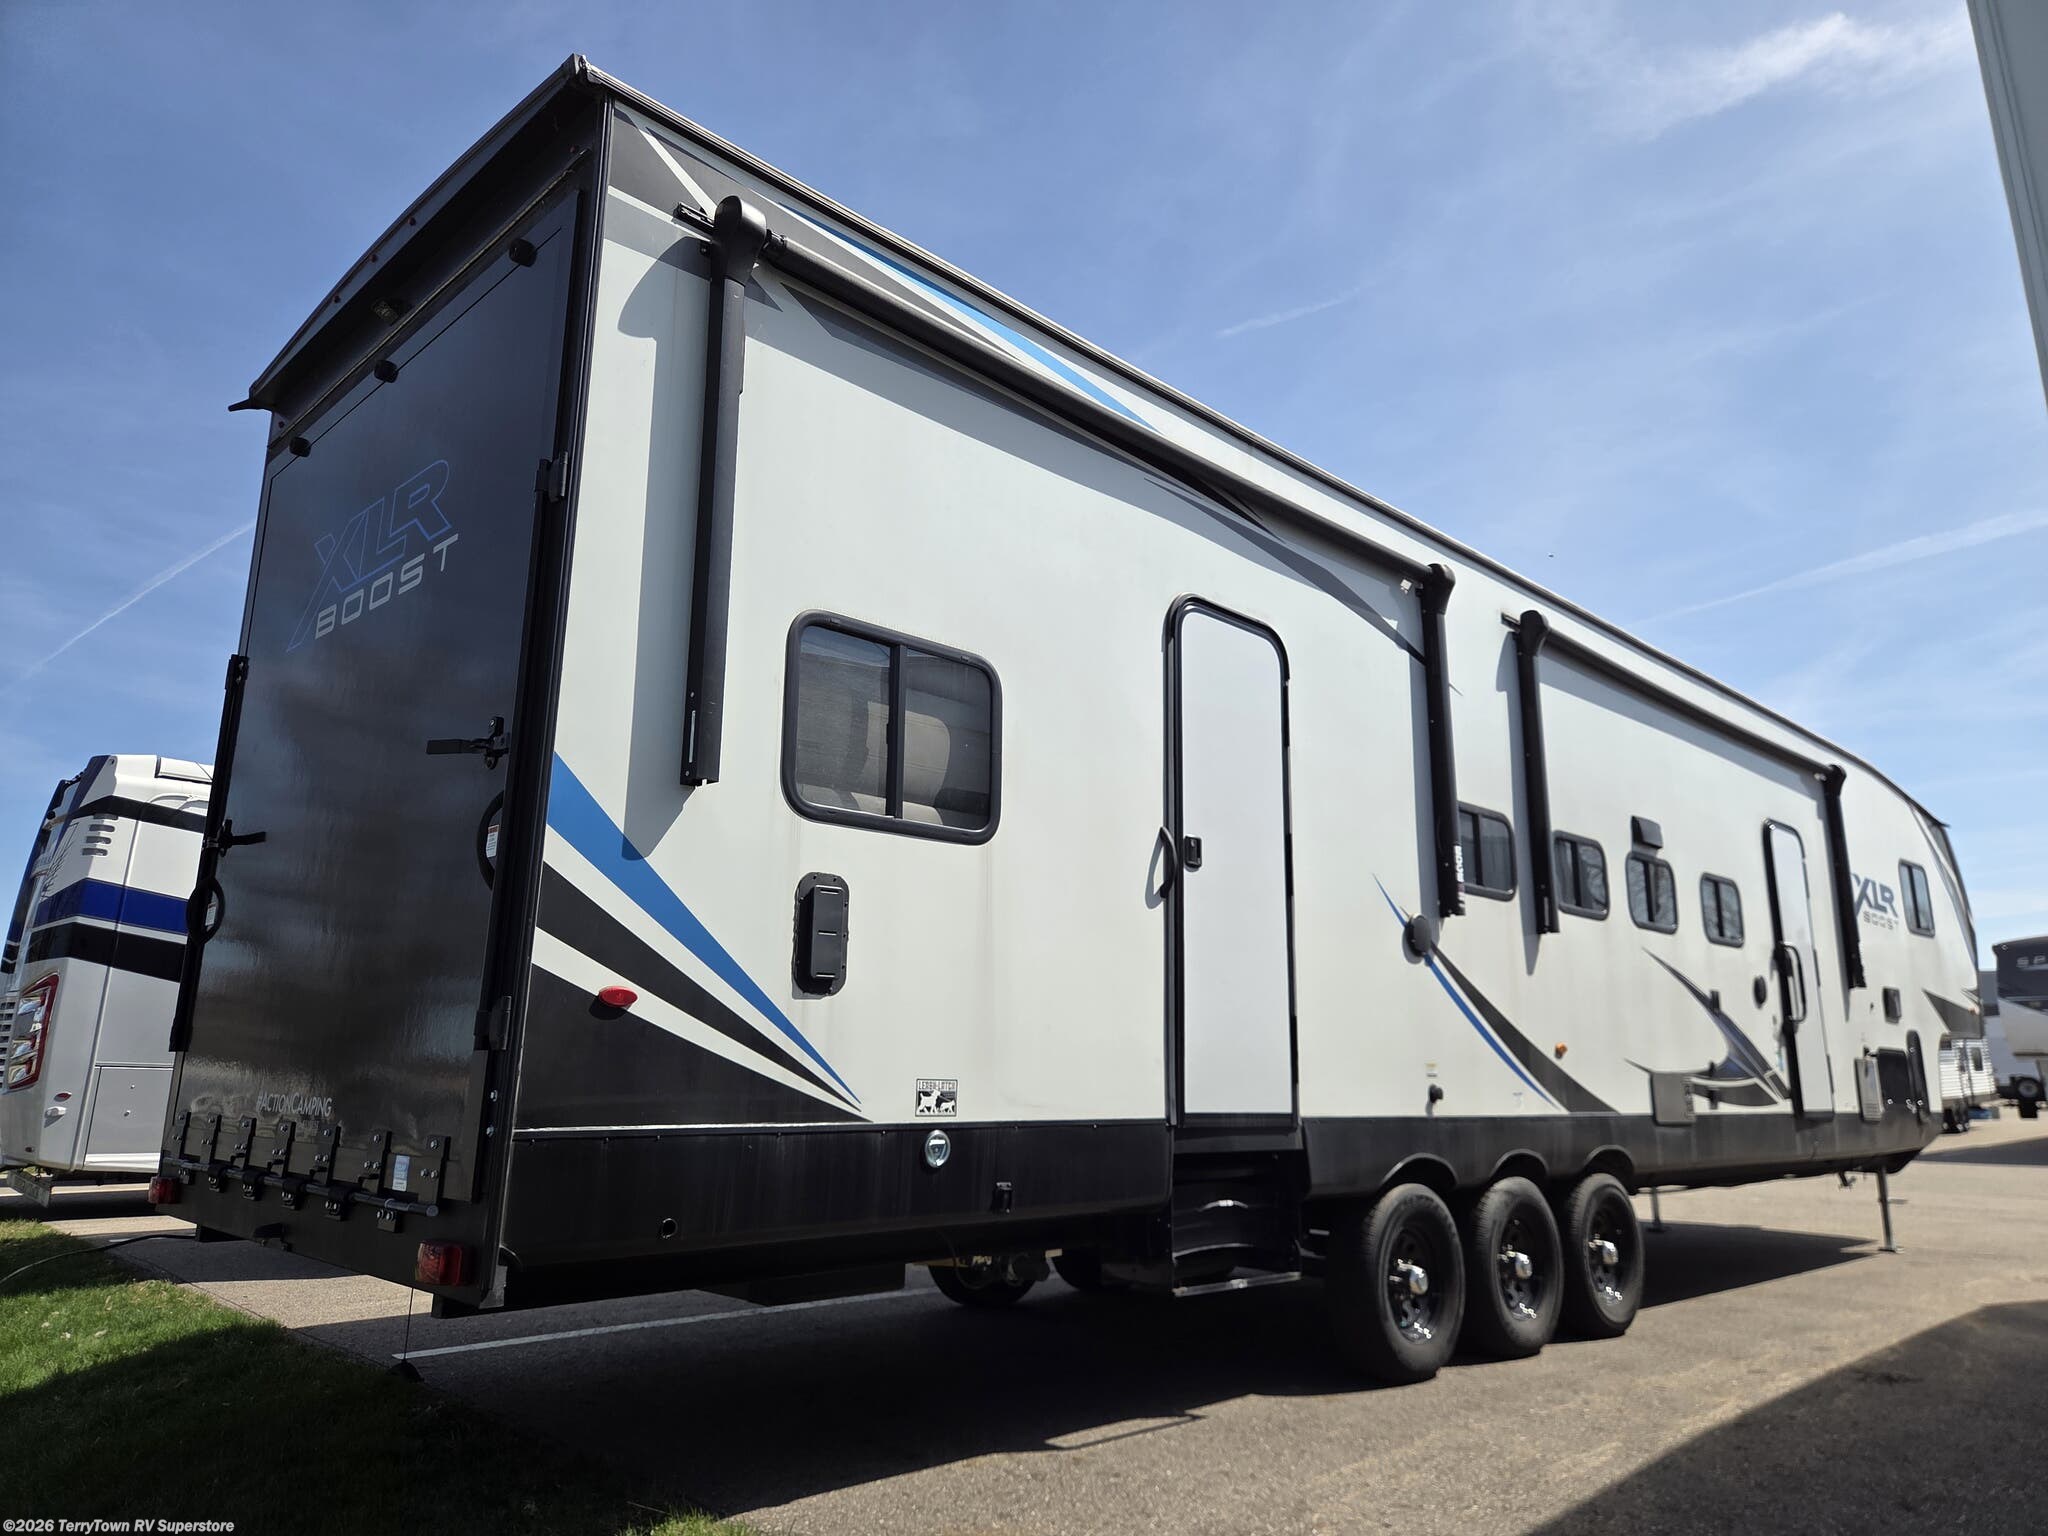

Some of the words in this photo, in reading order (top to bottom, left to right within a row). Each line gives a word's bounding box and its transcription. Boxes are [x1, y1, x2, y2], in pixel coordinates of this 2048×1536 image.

[286, 459, 452, 652] XLR
[315, 533, 459, 639] BOOST
[1851, 872, 1899, 918] XLR
